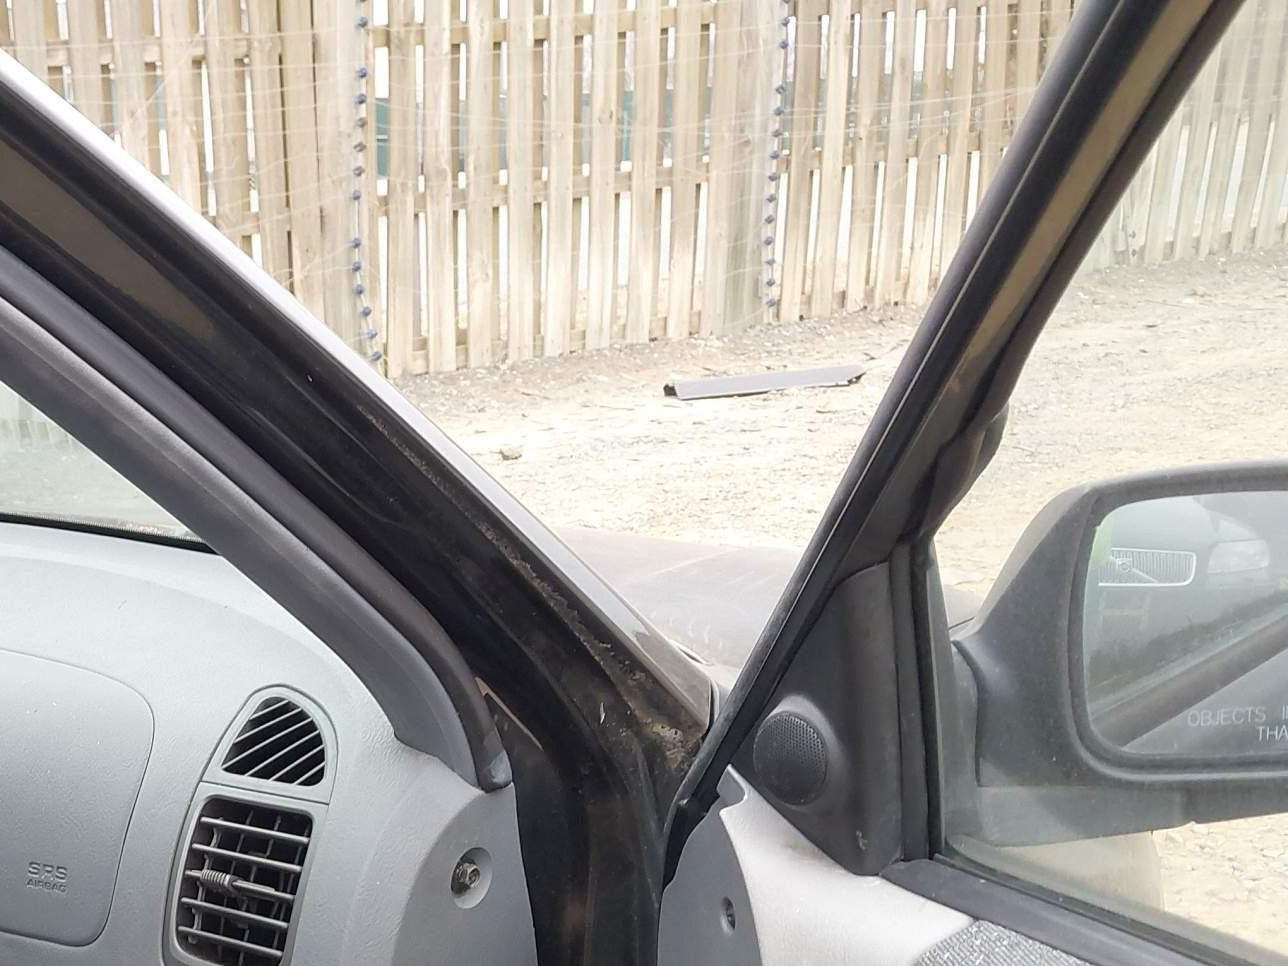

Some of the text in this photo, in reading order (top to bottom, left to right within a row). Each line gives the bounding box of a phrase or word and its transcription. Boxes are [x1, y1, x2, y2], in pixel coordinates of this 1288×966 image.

[1187, 706, 1267, 727] OBJECTS
[27, 861, 69, 882] SRS
[26, 878, 68, 893] AIRBAG
